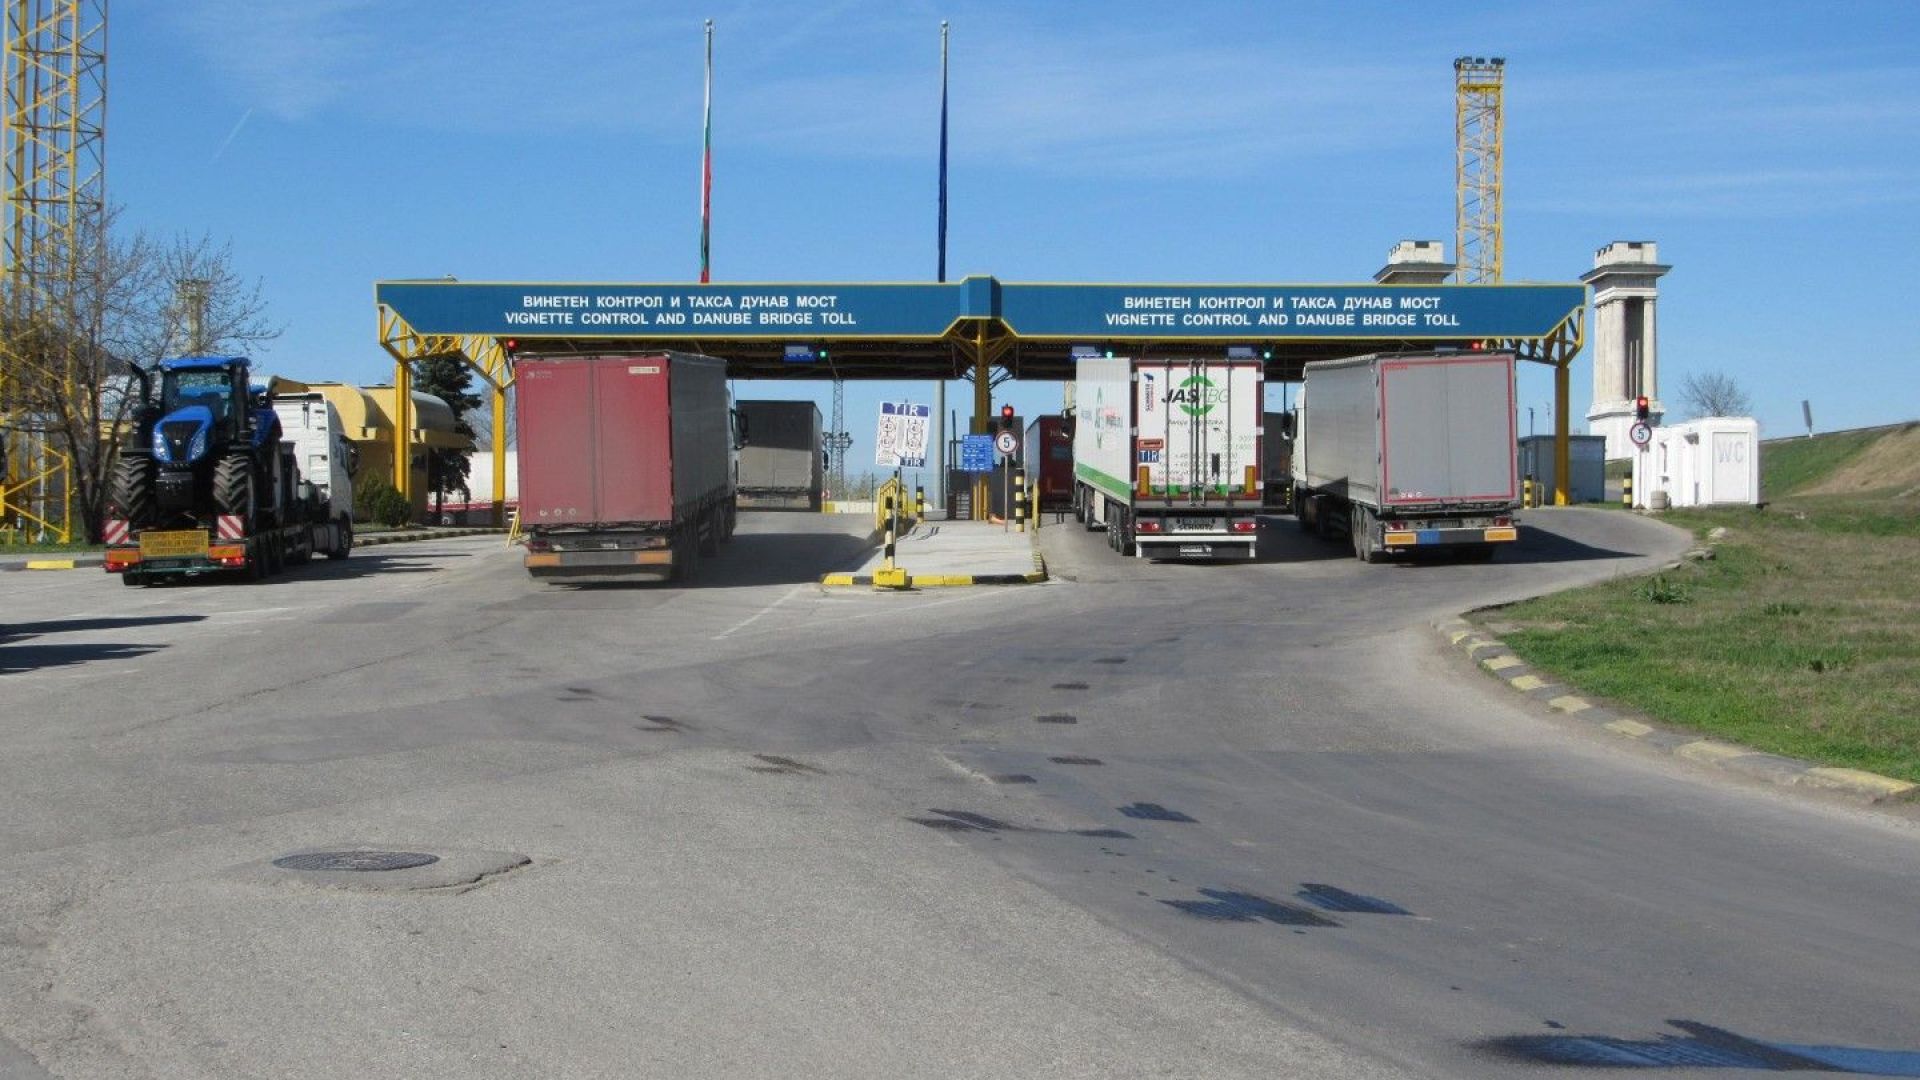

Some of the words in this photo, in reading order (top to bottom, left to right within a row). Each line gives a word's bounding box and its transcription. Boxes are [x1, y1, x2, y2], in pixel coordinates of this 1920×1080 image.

[523, 295, 589, 308] ВИНЕТЕН
[596, 295, 663, 308] КОНТРОЛ
[670, 295, 681, 308] И
[687, 295, 733, 308] ТАКСА
[739, 295, 789, 310] ДУНАВ
[796, 295, 837, 308] МОСТ
[1124, 296, 1192, 309] ВИНЕТЕН
[1199, 296, 1266, 309] КОНТРОЛ
[1273, 296, 1284, 309] И
[1290, 296, 1337, 309] ТАКСА
[1343, 296, 1393, 311] ДУНАВ
[1399, 296, 1441, 309] МОСТ
[504, 312, 574, 325] VIGNETTE
[580, 312, 649, 325] CONTROL
[655, 312, 686, 325] AND
[692, 312, 752, 325] DANUBE
[759, 312, 813, 325] BRIDGE
[820, 312, 857, 325] TOLL
[1105, 313, 1176, 326] VIGNETTE
[1182, 313, 1252, 326] CONTROL
[1257, 313, 1289, 326] AND
[1295, 313, 1356, 326] DANUBE
[1362, 313, 1417, 326] BRIDGE
[1423, 313, 1460, 326] TOLL
[892, 403, 918, 417] TIR
[1637, 428, 1645, 440] 5
[1003, 437, 1010, 448] 5
[1139, 449, 1158, 463] TIR
[1717, 440, 1744, 463] WC
